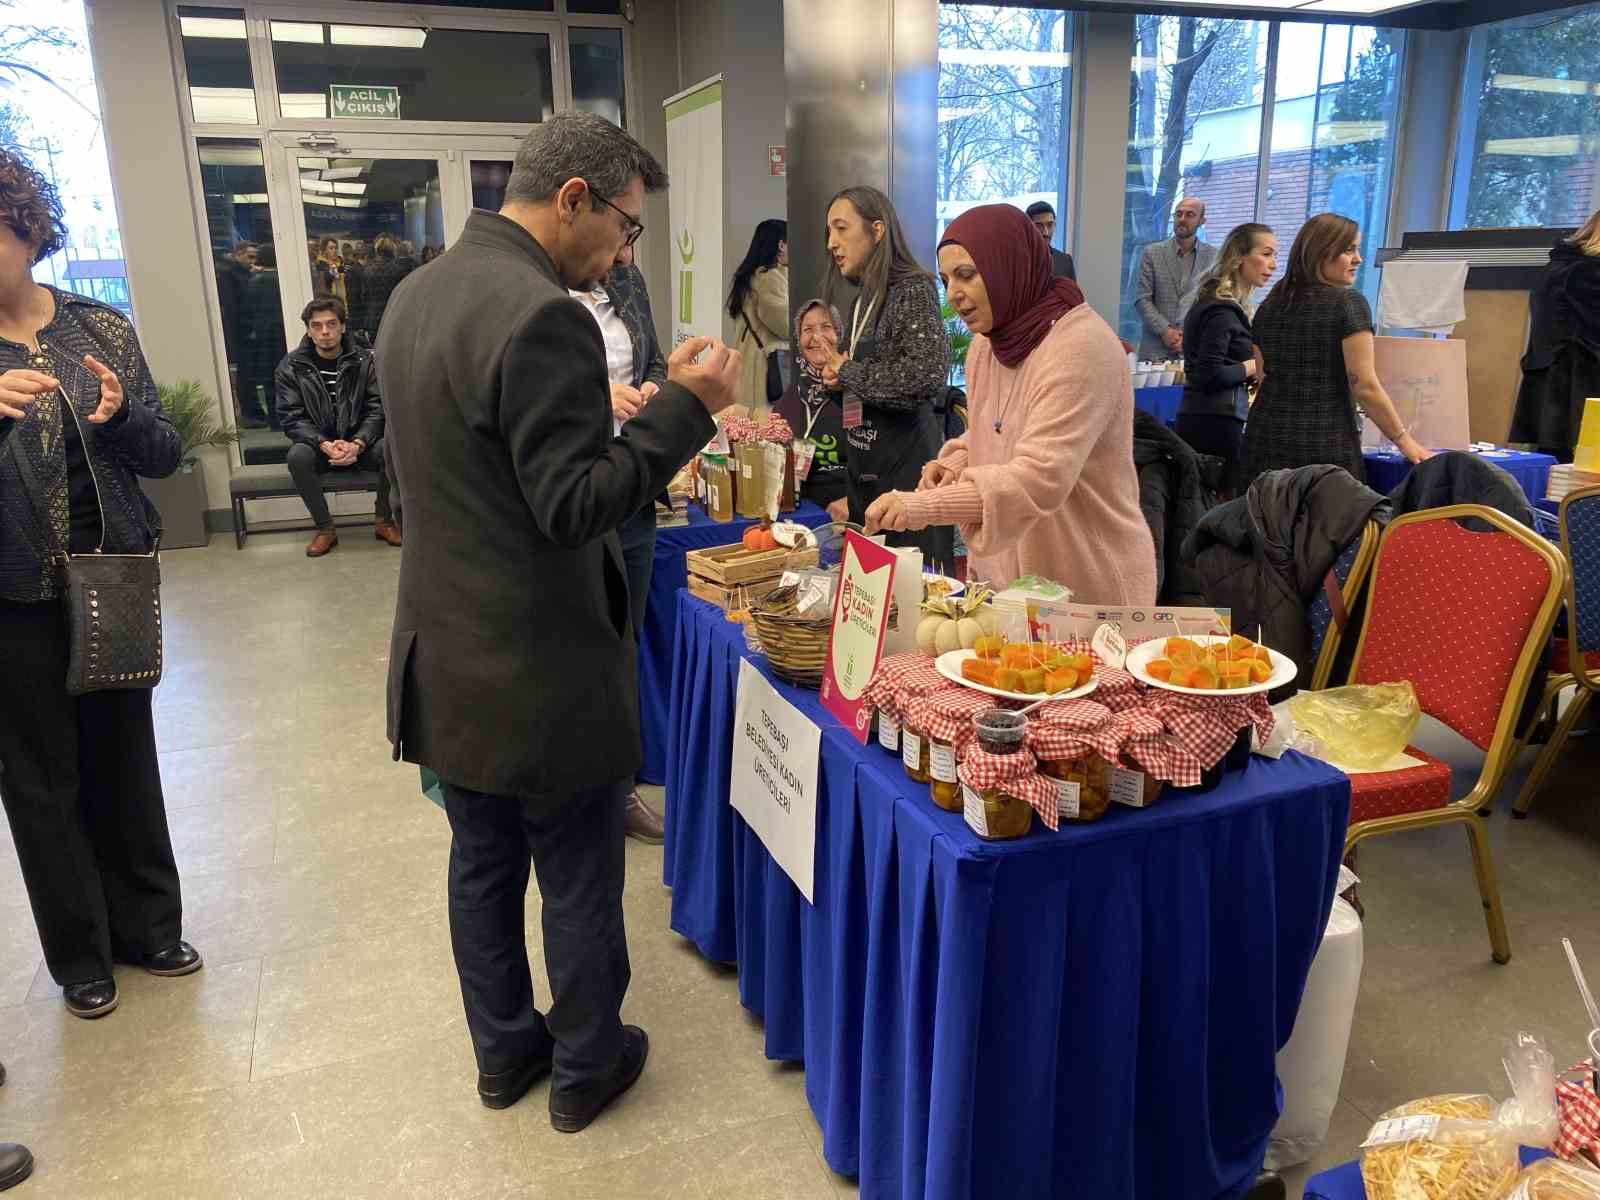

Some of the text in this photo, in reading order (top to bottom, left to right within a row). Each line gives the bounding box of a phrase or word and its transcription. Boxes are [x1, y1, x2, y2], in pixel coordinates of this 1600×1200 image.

[349, 90, 382, 101] ACİL
[347, 103, 386, 115] ÇIKIŞ
[852, 597, 873, 621] KADIN
[1153, 612, 1174, 622] GPD
[745, 721, 804, 798] BELEDİYESİ KADIN
[754, 756, 791, 815] ÜRETİCİLERİ
